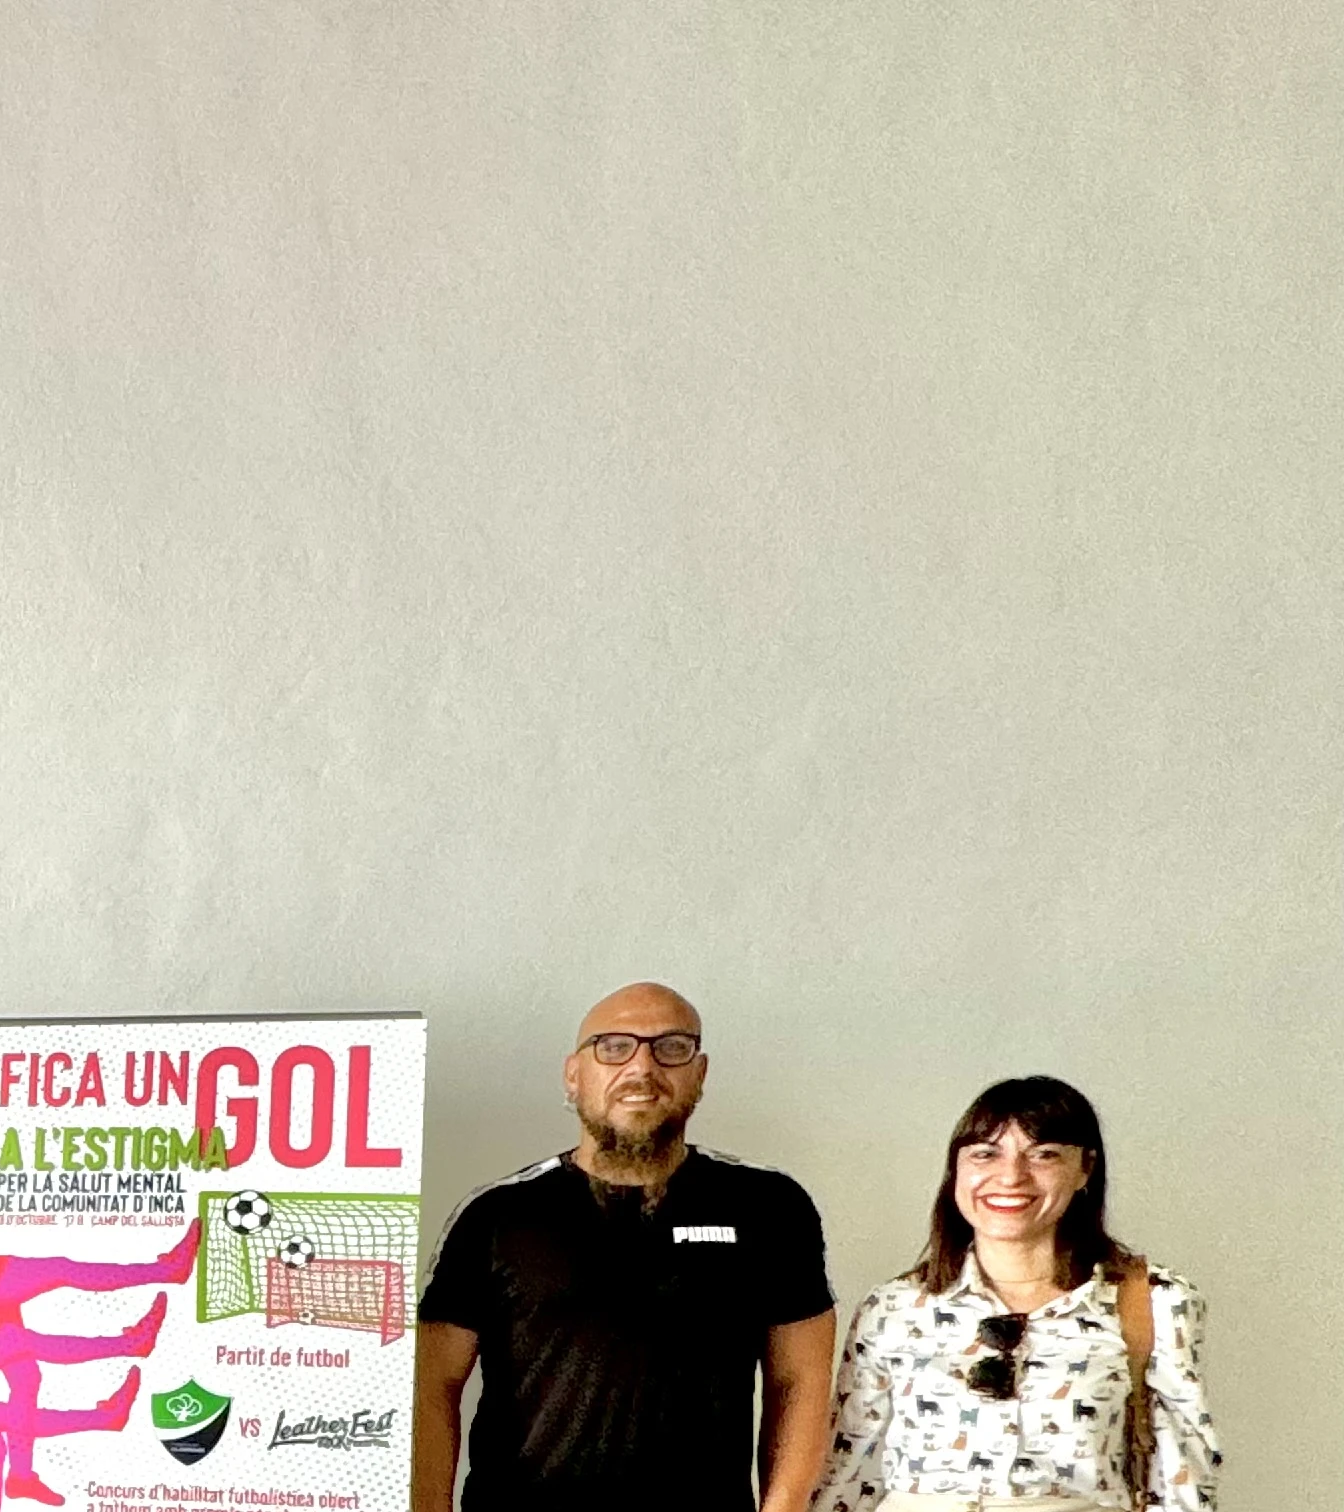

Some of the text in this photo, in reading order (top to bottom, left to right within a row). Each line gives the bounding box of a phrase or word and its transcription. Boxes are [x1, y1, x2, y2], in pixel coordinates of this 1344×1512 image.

[124, 1050, 191, 1107] UN
[195, 1044, 403, 1169] GOL
[34, 1126, 230, 1171] L'ESTIGMA
[32, 1173, 54, 1193] LA
[59, 1172, 113, 1193] SALUT
[117, 1173, 187, 1193] MENTAL
[18, 1194, 38, 1212] LA
[42, 1194, 129, 1212] COMUNITAT
[133, 1194, 185, 1213] D'INCA
[672, 1226, 737, 1244] PUMA
[216, 1345, 350, 1369] Partit de futbol
[88, 1481, 145, 1500] Concurs
